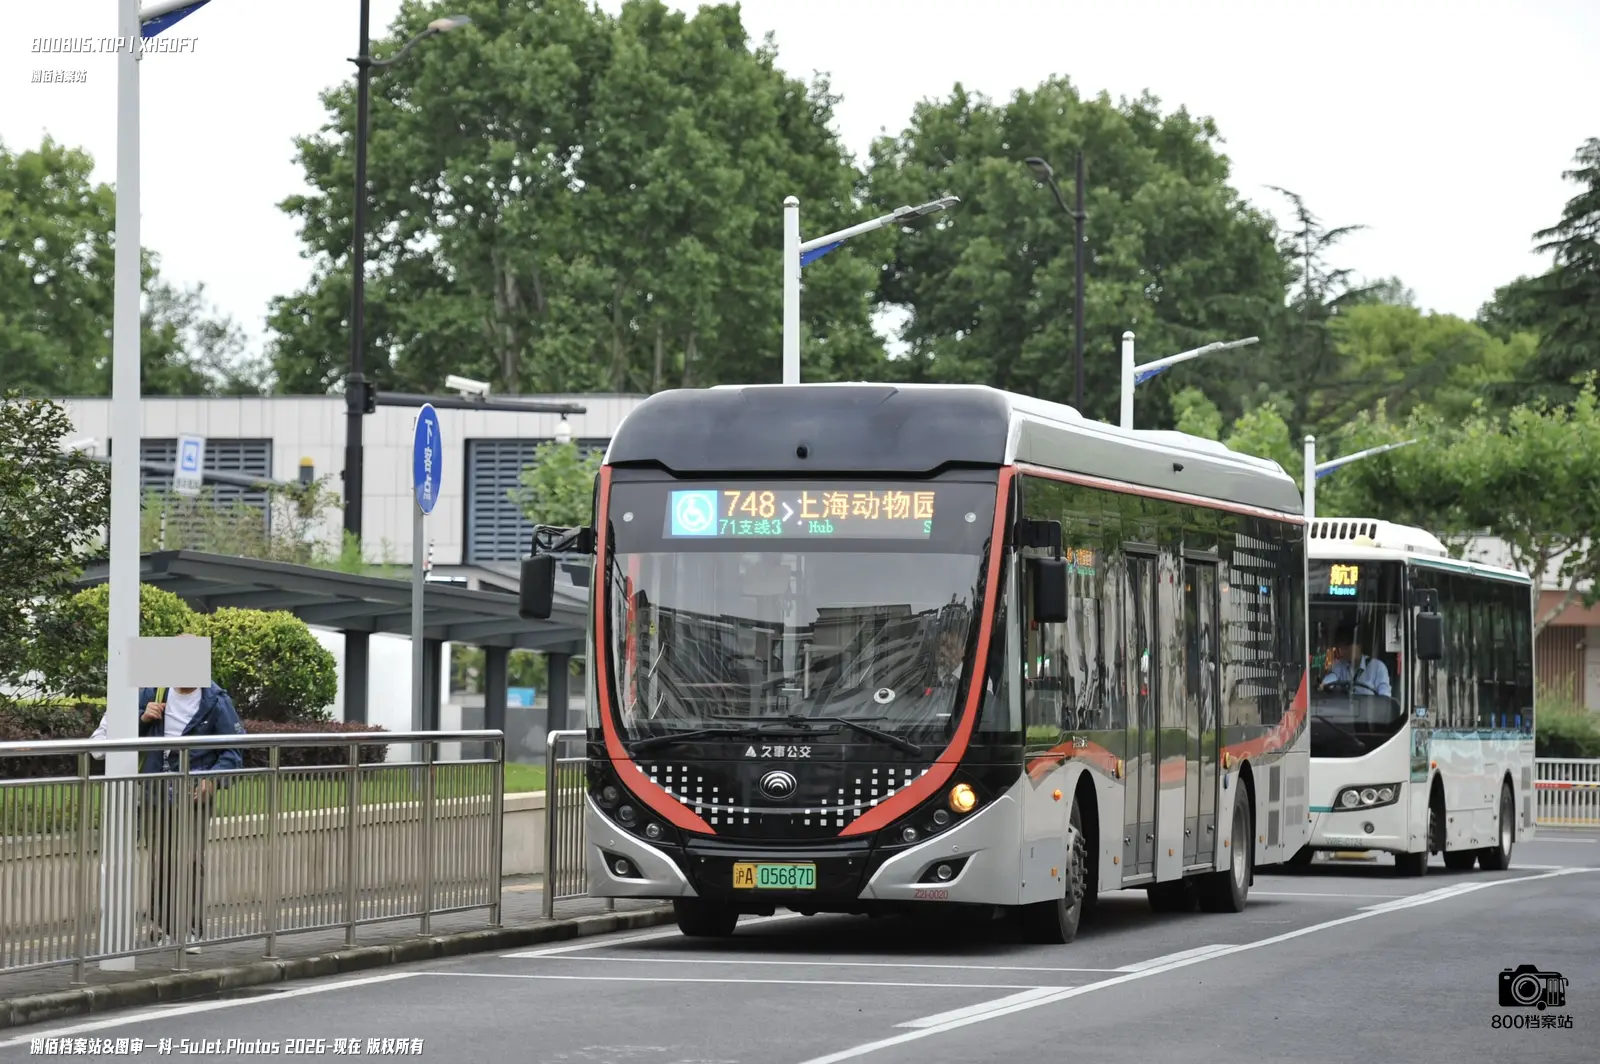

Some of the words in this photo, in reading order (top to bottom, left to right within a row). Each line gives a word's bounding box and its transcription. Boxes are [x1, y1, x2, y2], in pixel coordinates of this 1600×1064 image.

[423, 418, 434, 501] 下客点
[723, 490, 775, 518] 748
[799, 490, 936, 520] 上海动物园
[808, 519, 834, 533] Hub
[761, 745, 812, 758] 久事公交
